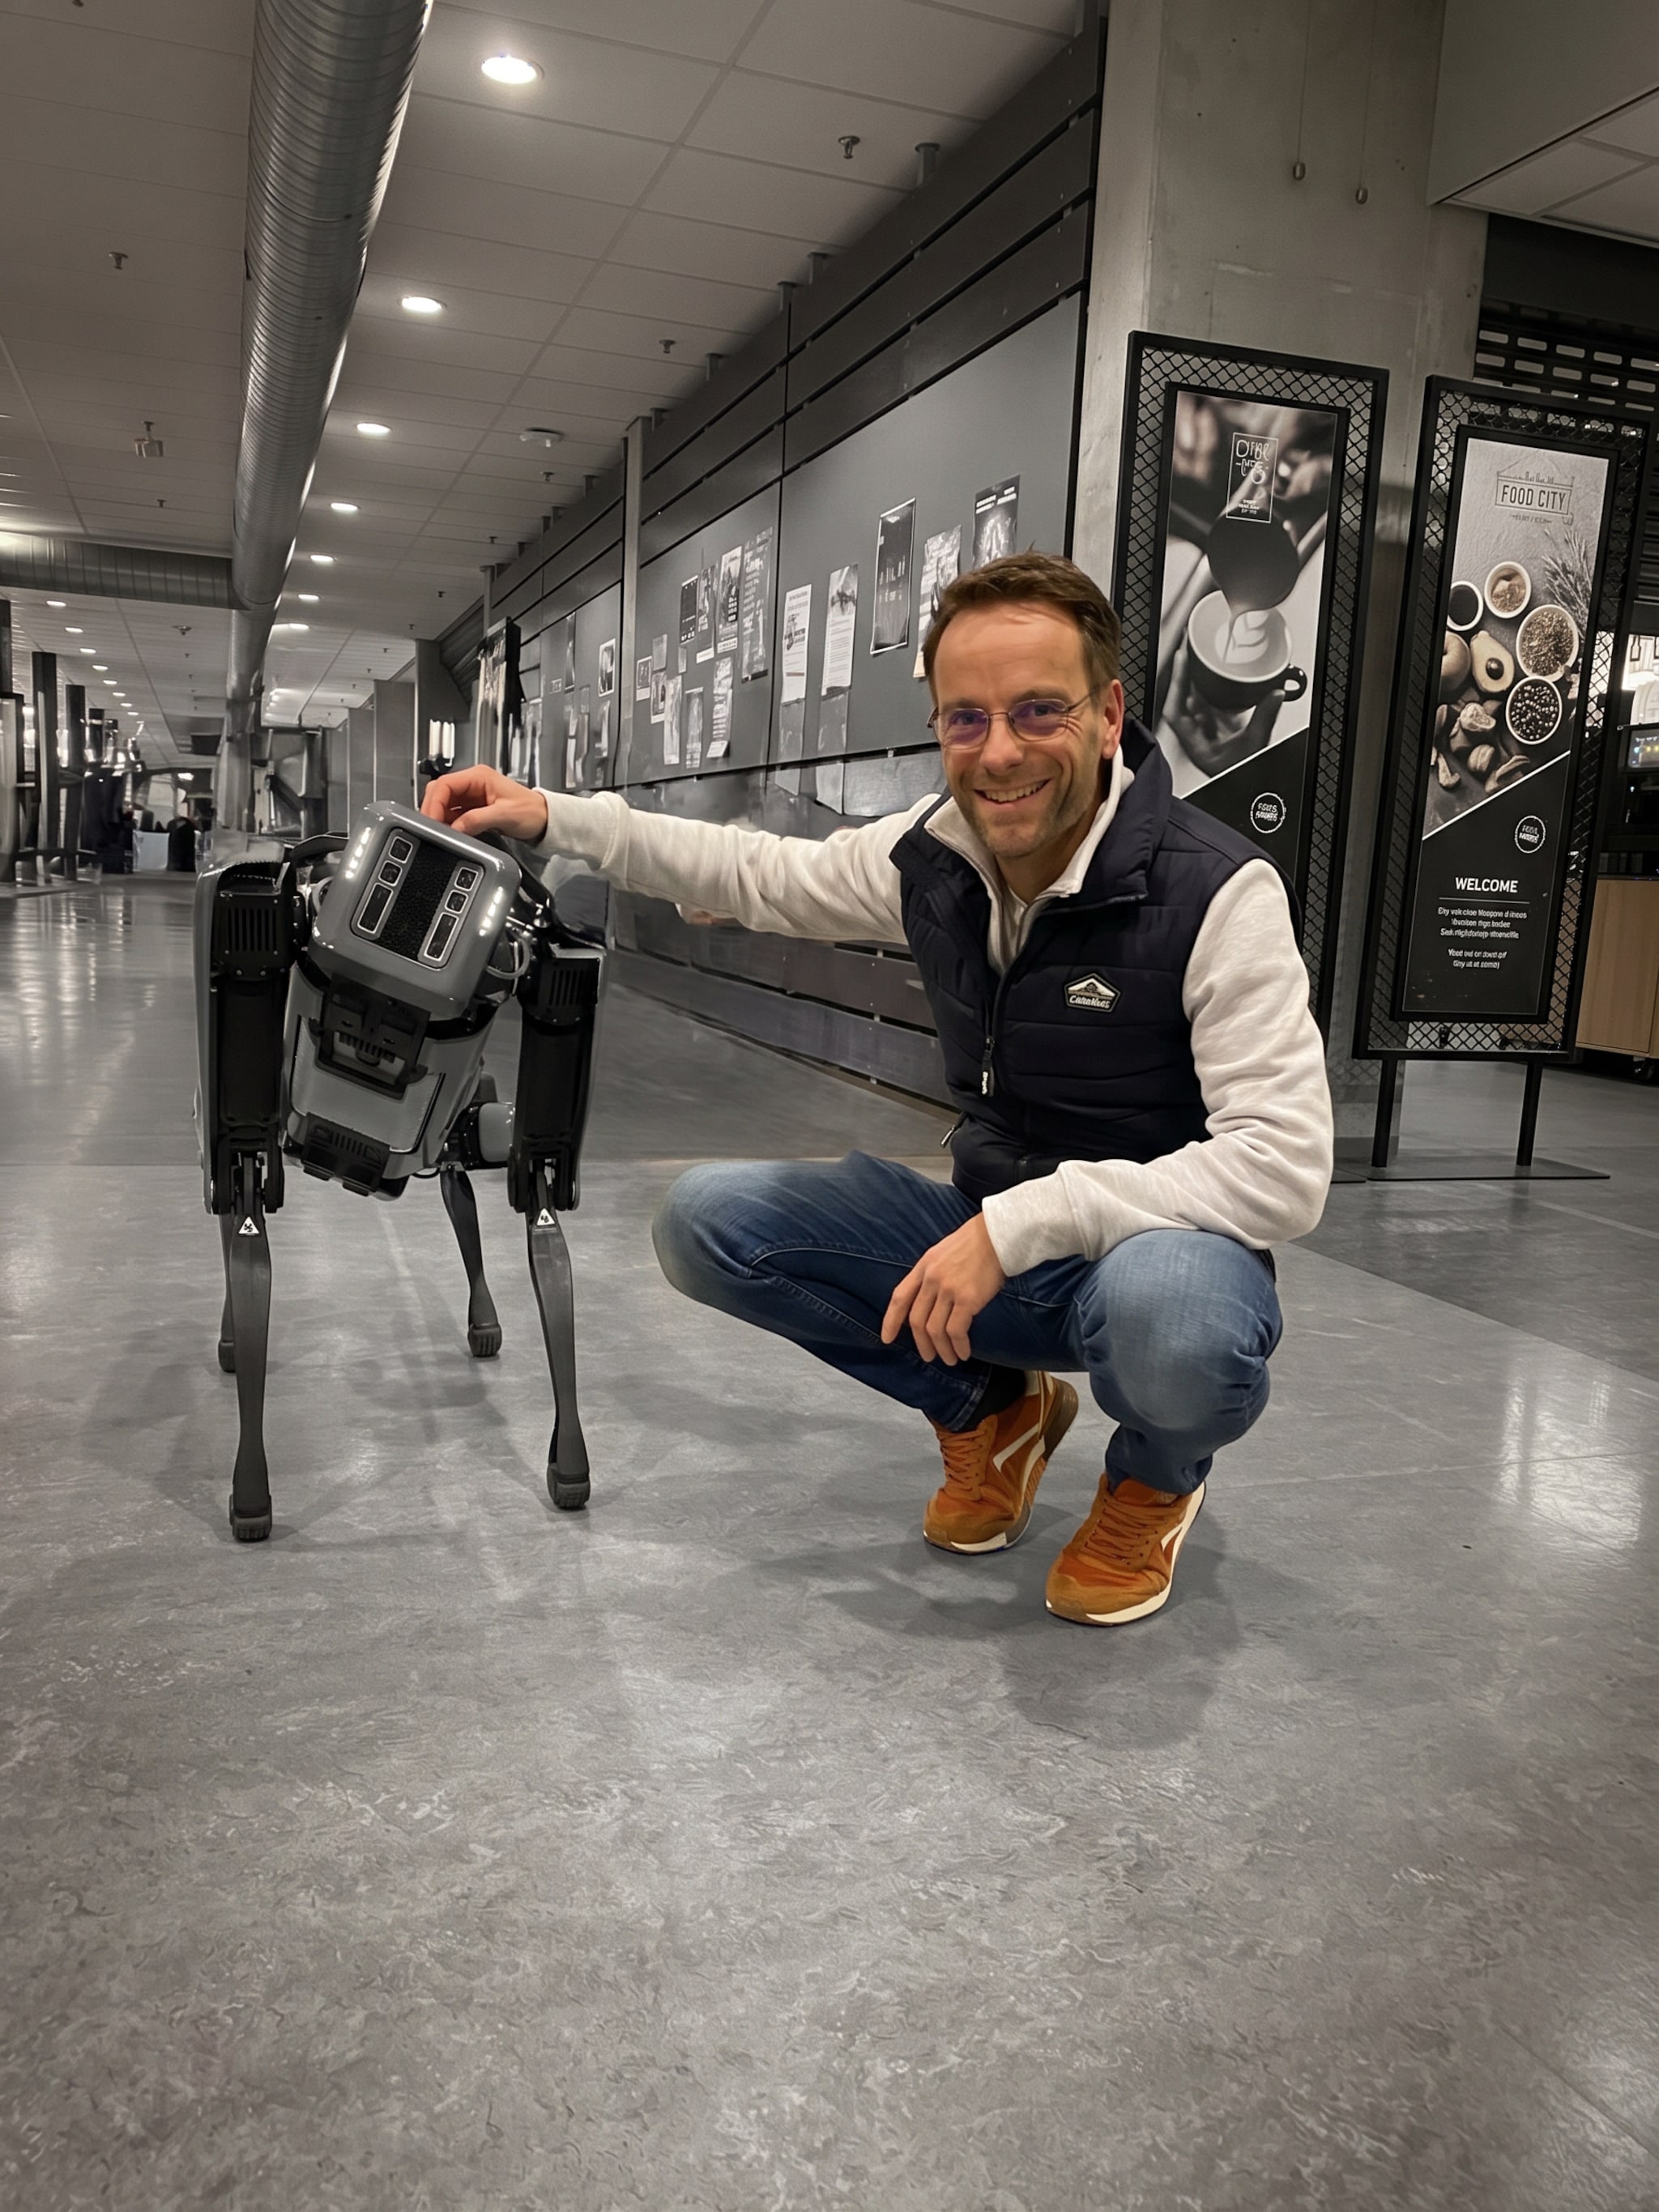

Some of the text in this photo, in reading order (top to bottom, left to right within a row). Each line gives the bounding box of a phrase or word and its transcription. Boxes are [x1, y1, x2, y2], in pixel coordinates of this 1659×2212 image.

[1501, 484, 1566, 511] FOOD CITY
[1455, 876, 1519, 893] WELCOME
